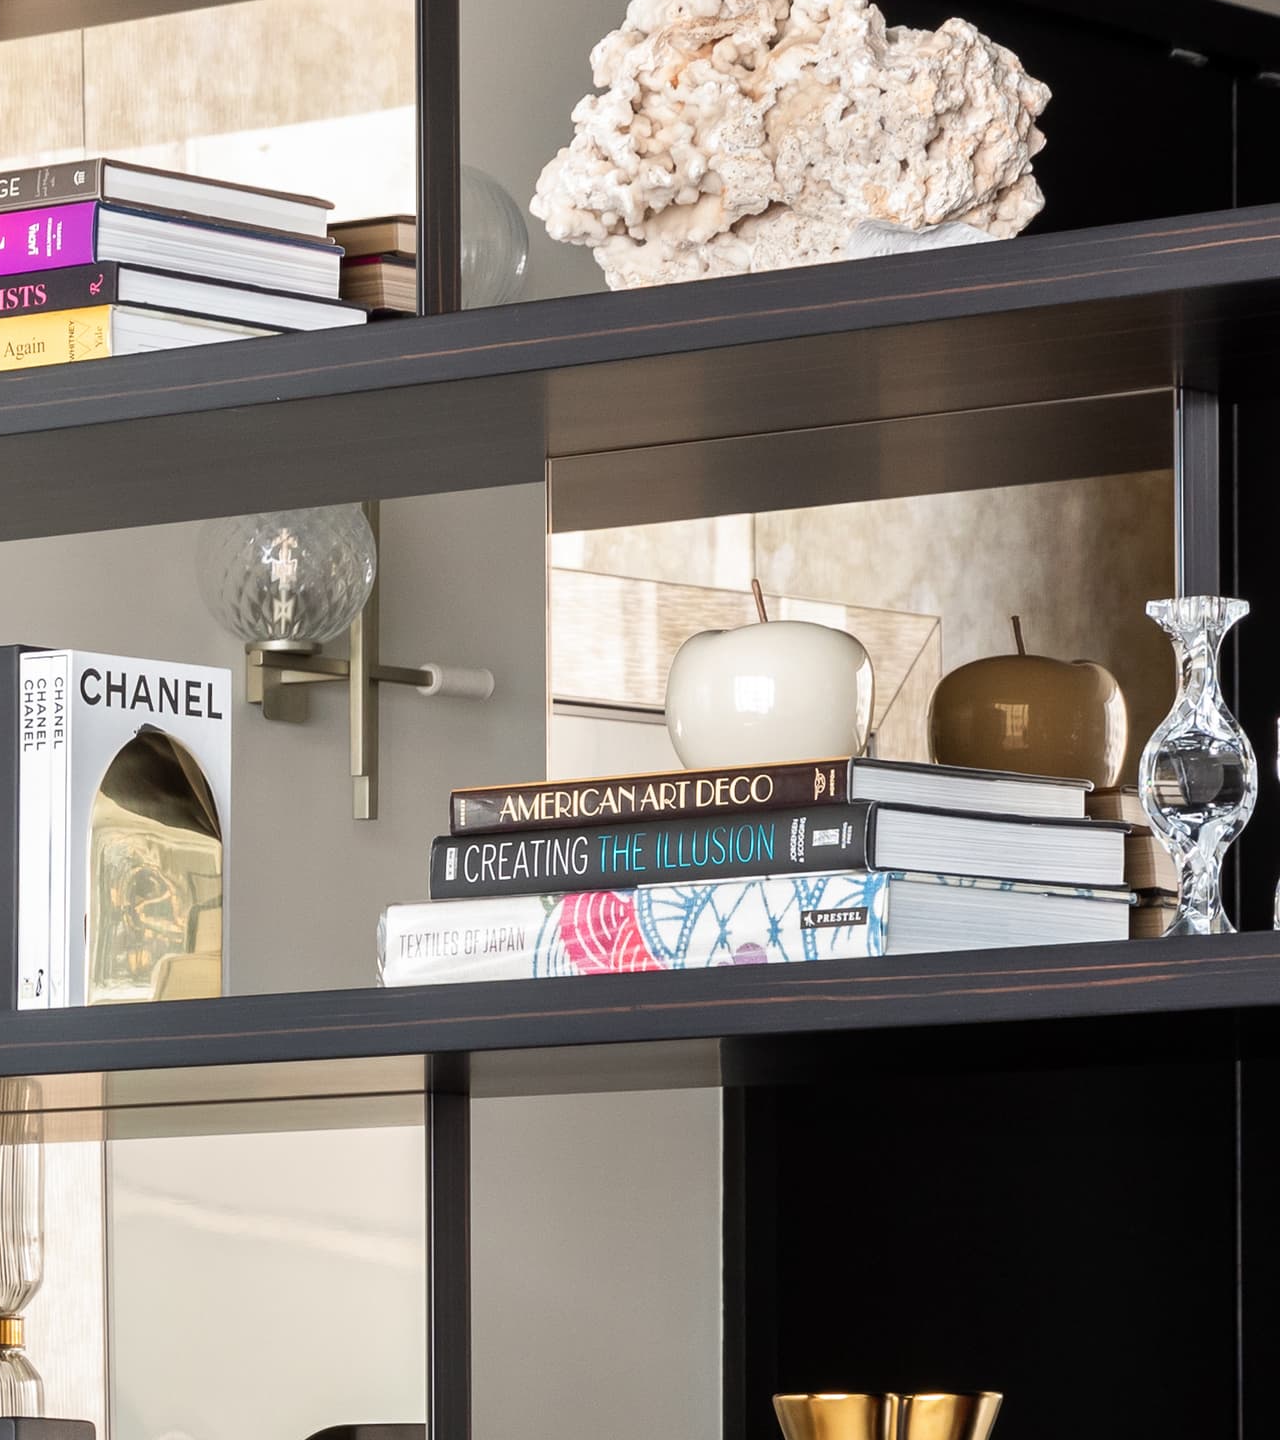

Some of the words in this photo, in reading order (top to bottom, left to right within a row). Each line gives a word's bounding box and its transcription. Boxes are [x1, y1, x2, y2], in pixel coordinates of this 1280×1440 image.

[4, 336, 46, 361] Again
[24, 679, 34, 752] CHANEL
[36, 678, 47, 751] CHANEL
[53, 676, 64, 750] CHANEL
[79, 667, 224, 720] CHANEL
[499, 785, 636, 823] AMERICAN
[640, 781, 691, 812] ART
[696, 774, 774, 808] DECO
[464, 835, 589, 883] CREATING
[597, 832, 647, 873] THE
[656, 823, 776, 869] ILLUSION
[400, 930, 460, 959] TEXTILES
[464, 929, 481, 955] OF
[483, 927, 526, 954] JAPAN
[816, 910, 862, 924] PRESTEL
